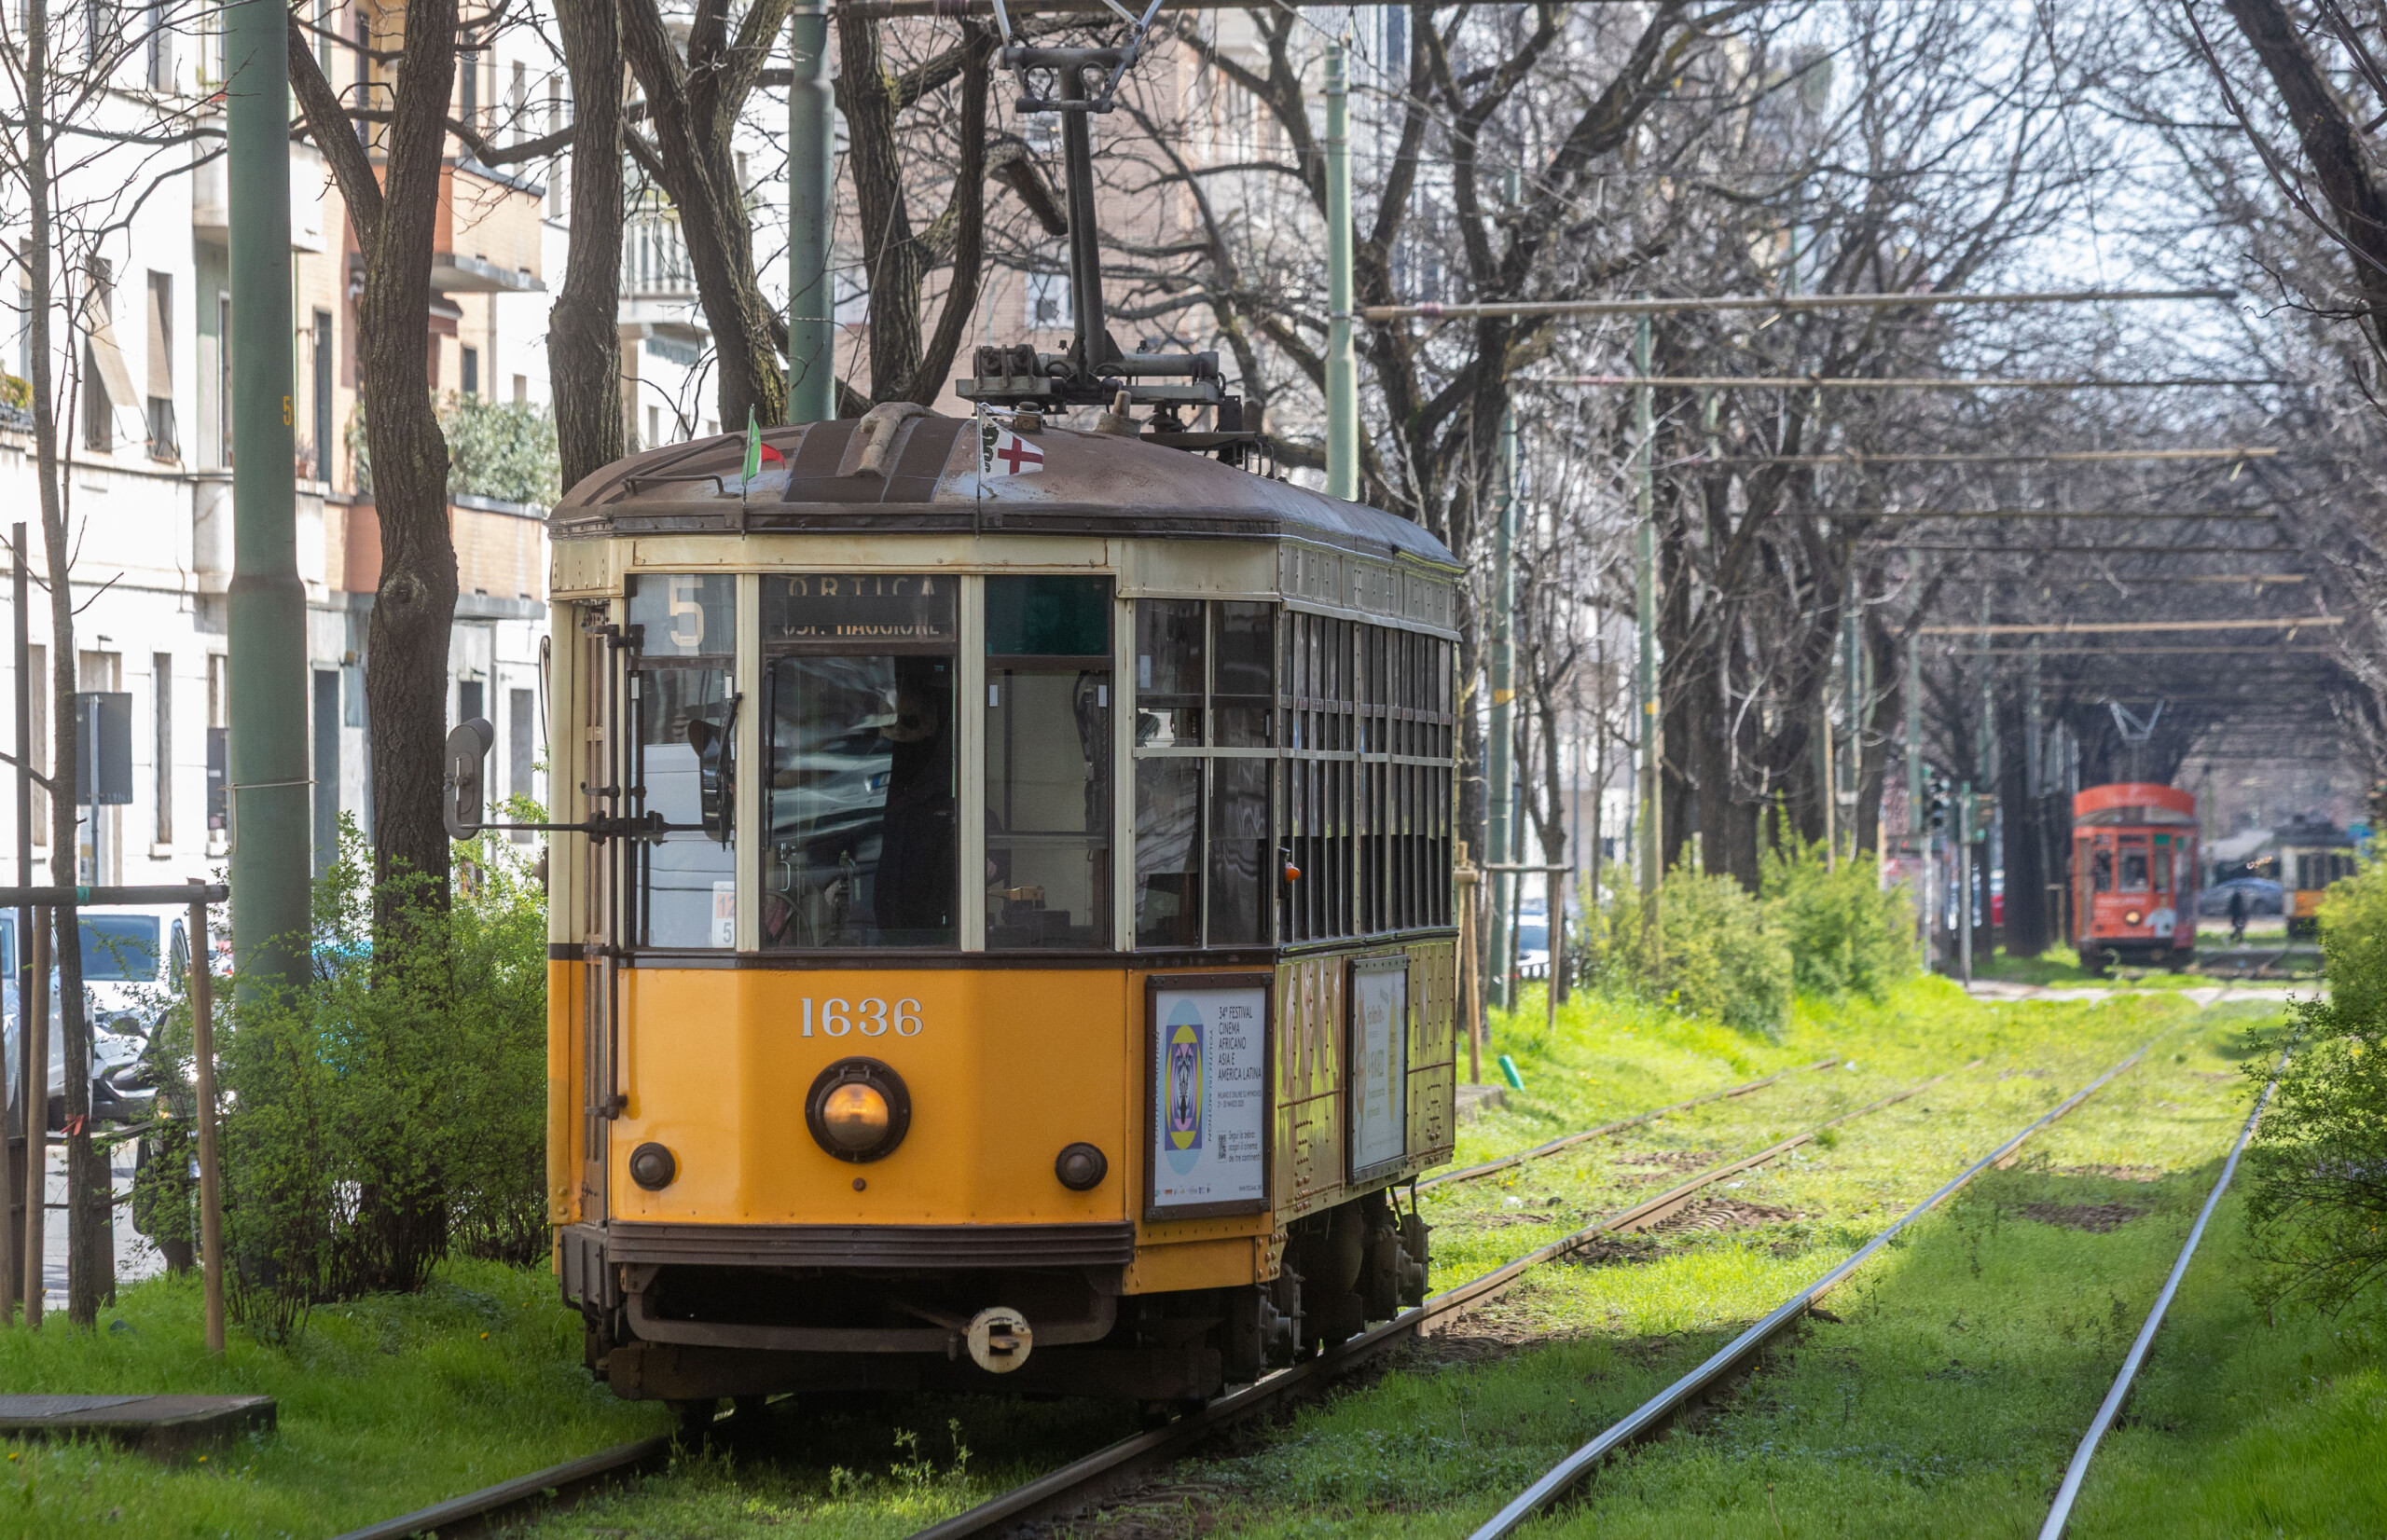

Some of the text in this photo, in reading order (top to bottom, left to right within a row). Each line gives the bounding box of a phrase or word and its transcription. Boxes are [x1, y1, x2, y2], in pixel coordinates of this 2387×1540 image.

[788, 576, 935, 596] ORTICA
[669, 577, 704, 646] 5
[801, 997, 923, 1037] 1636
[1229, 1005, 1253, 1020] FESTIVAL
[1218, 1022, 1240, 1035] CINEMA
[1218, 1037, 1247, 1050] AFRICANO
[1218, 1052, 1235, 1066] ASIA E
[1218, 1066, 1262, 1081] AMERICA LATINA
